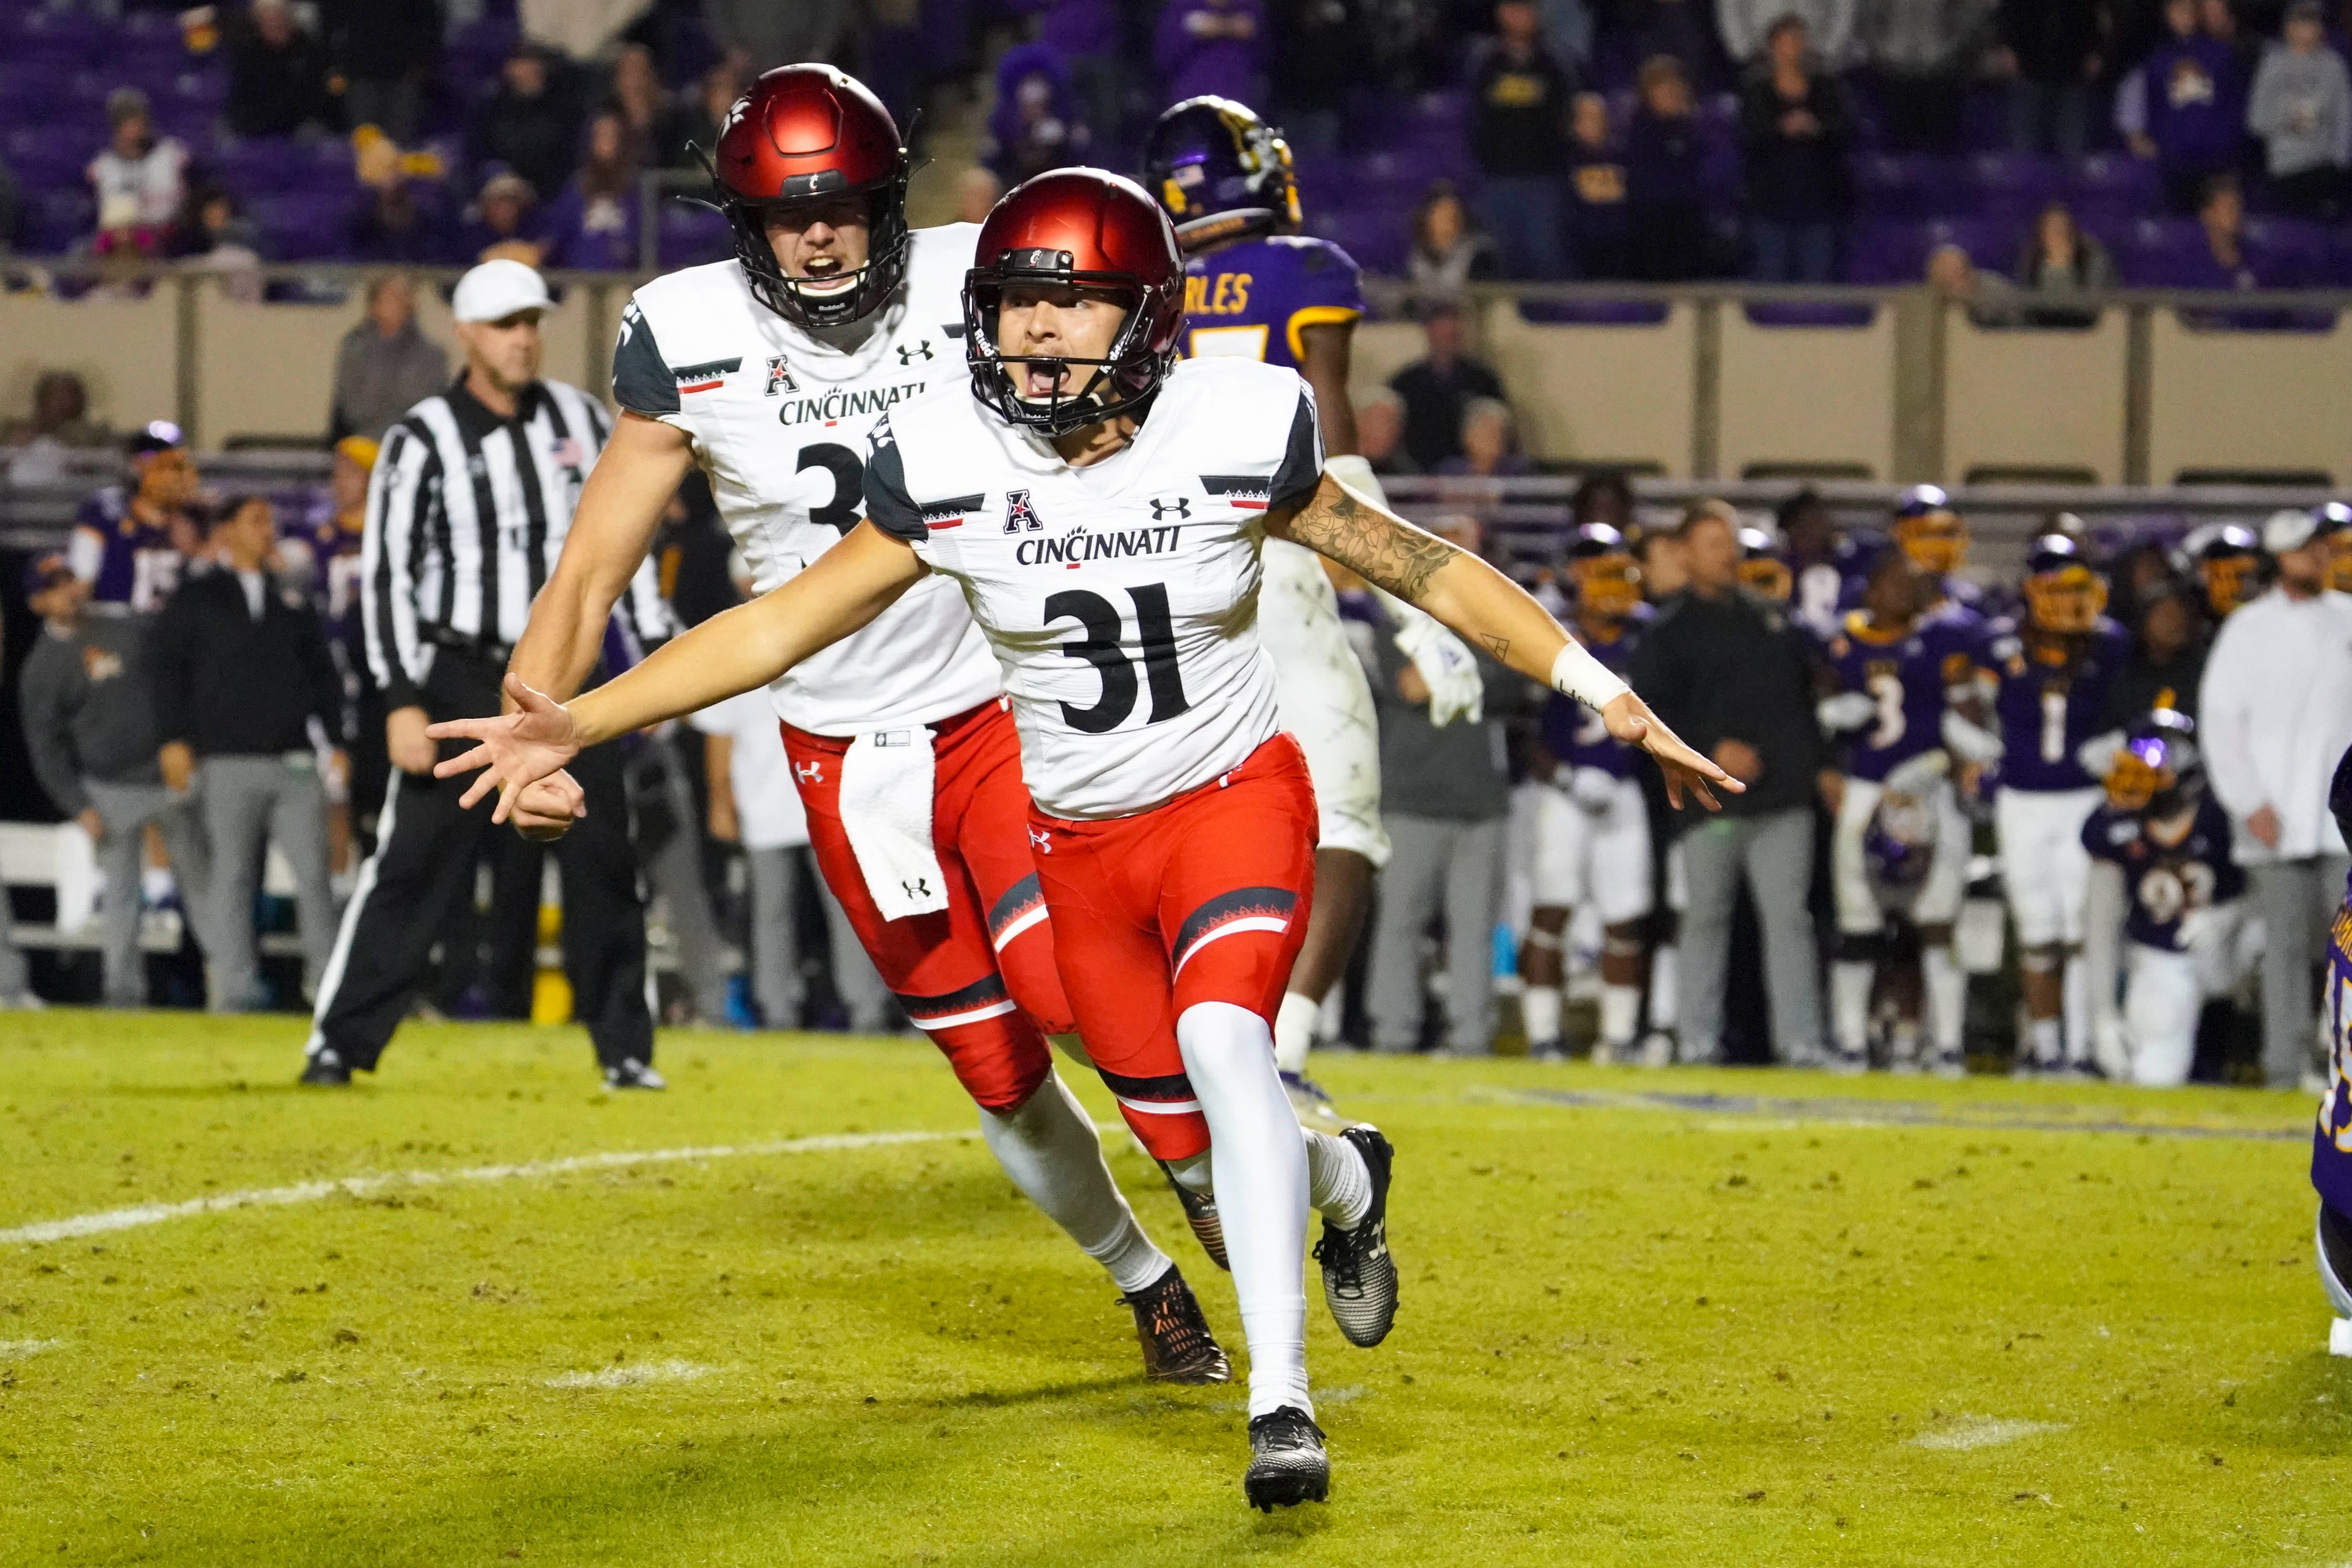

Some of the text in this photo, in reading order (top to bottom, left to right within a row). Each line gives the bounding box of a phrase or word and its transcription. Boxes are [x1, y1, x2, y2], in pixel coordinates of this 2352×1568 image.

[764, 355, 800, 397] A
[1003, 489, 1043, 535] A
[1016, 525, 1182, 568] CINCINNATI
[1044, 582, 1192, 733] 31
[1868, 673, 1907, 751] 3
[2041, 693, 2068, 764] 1
